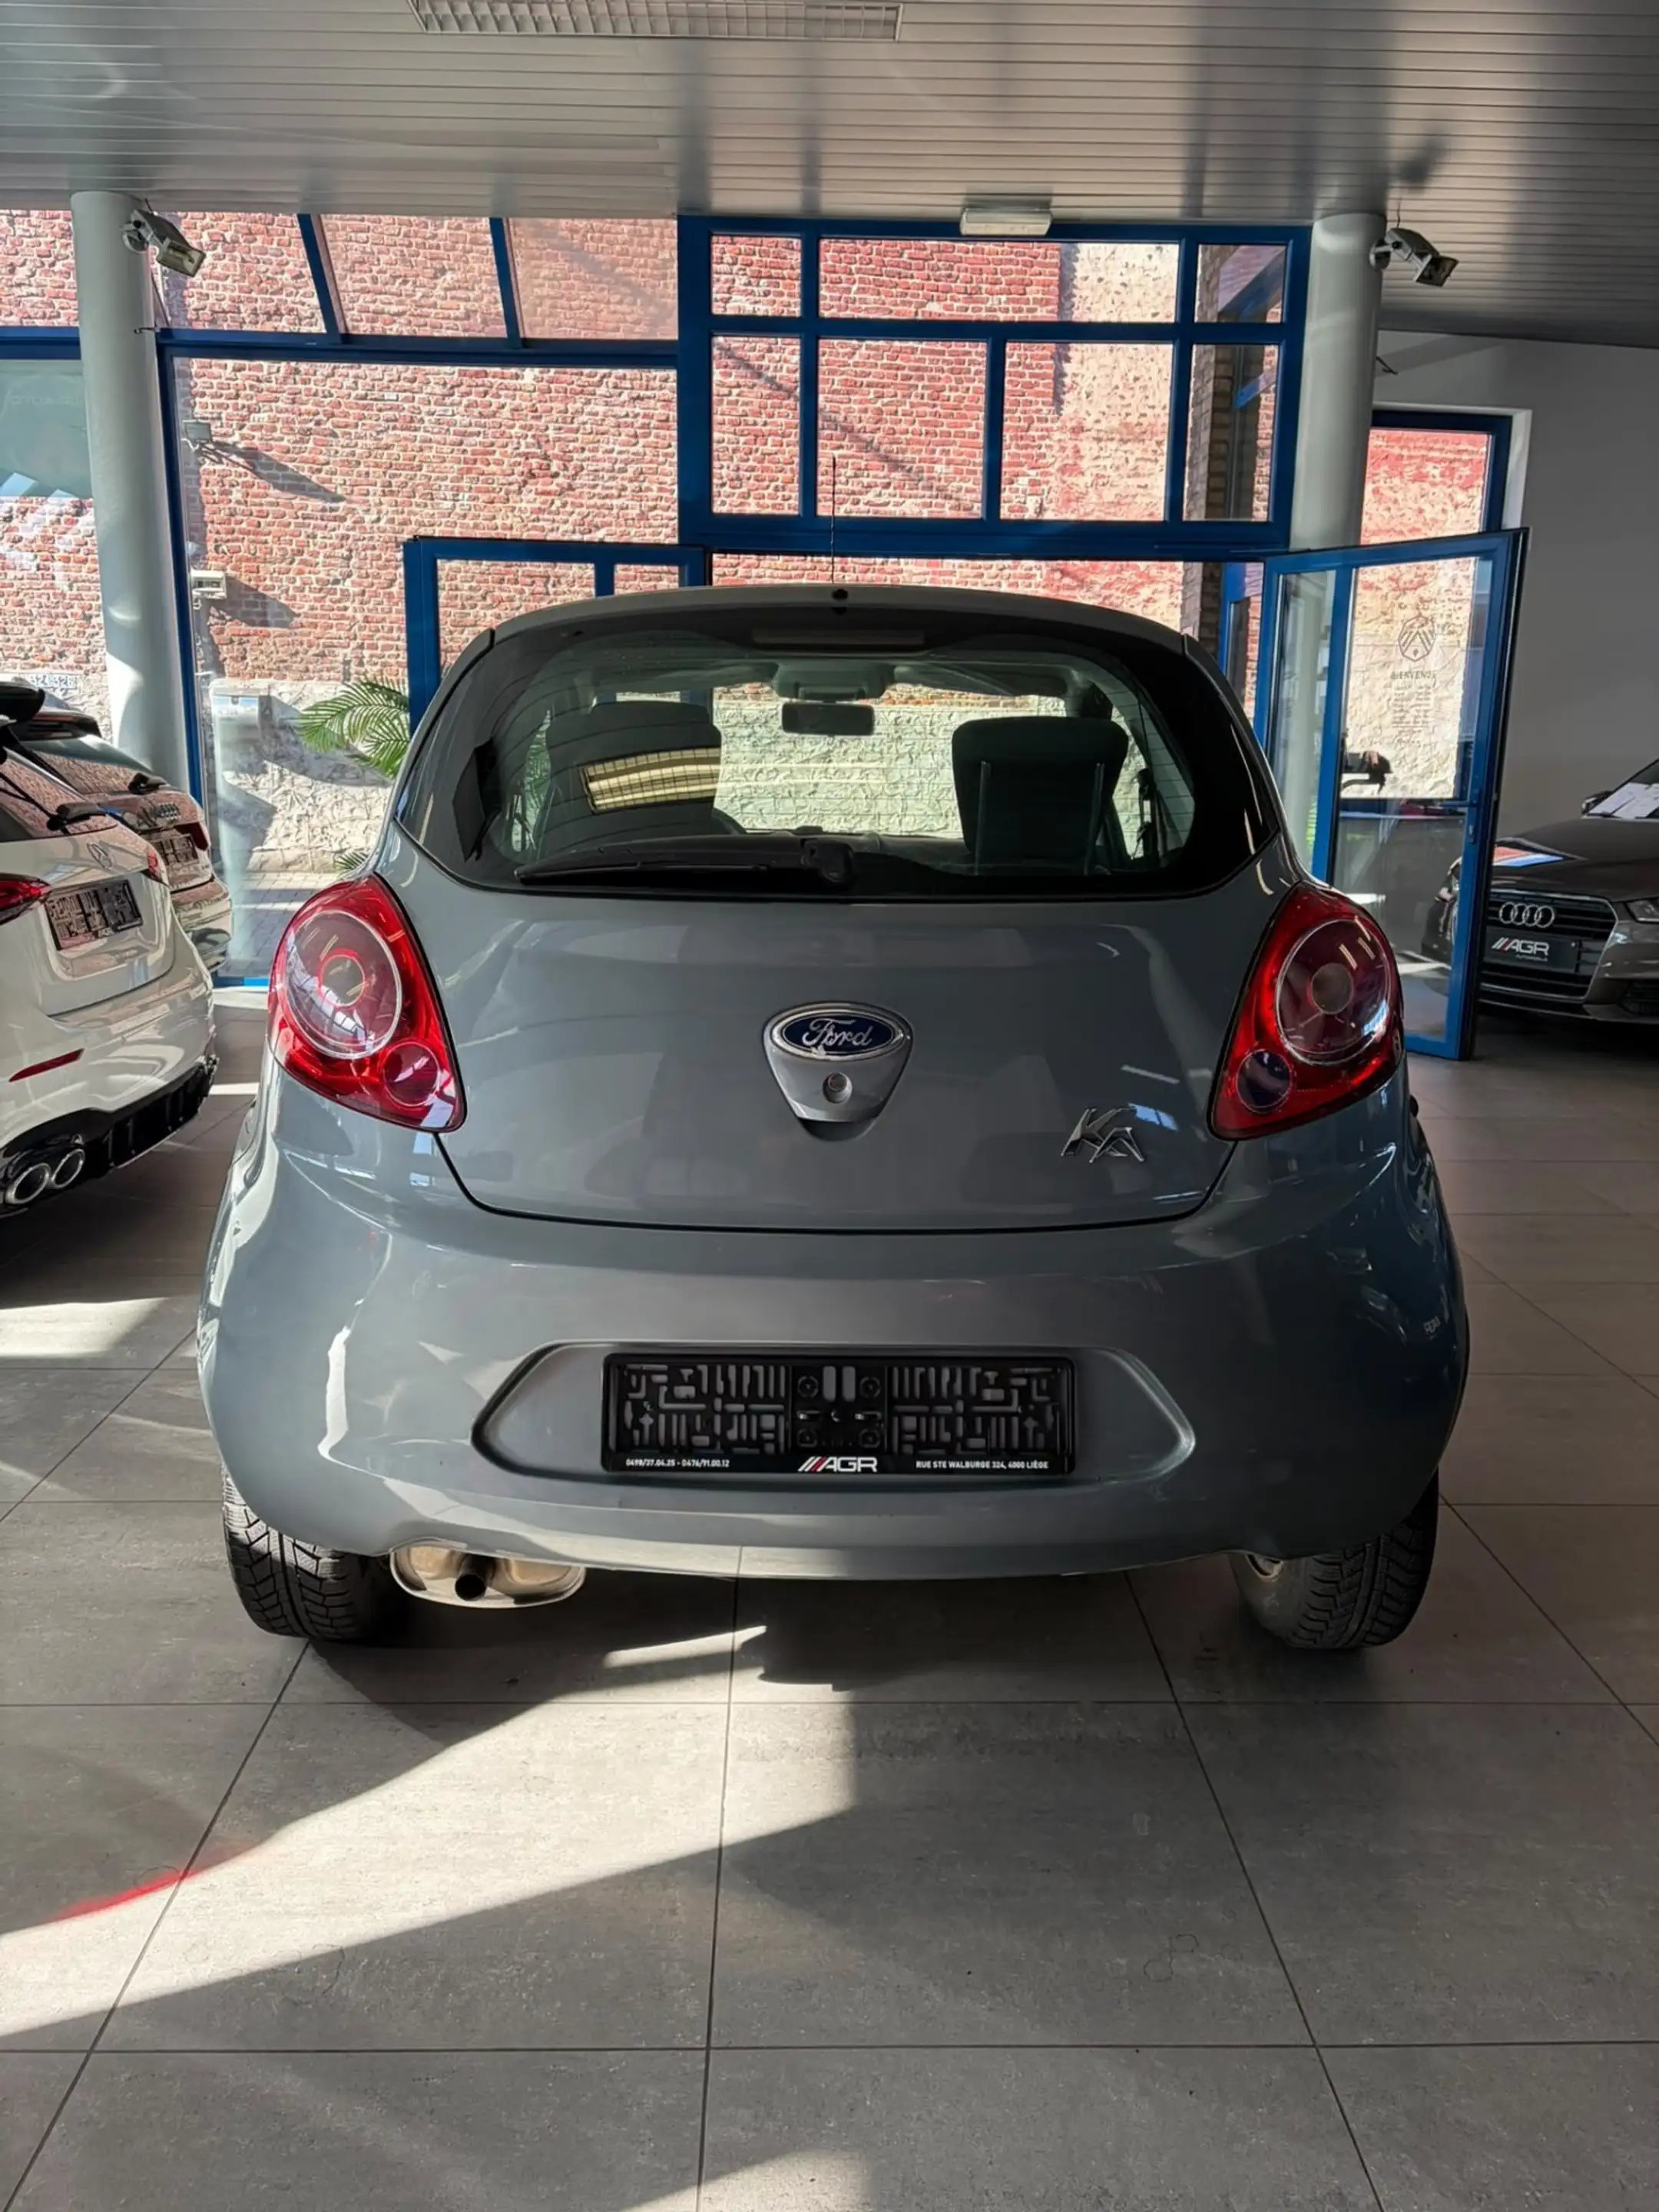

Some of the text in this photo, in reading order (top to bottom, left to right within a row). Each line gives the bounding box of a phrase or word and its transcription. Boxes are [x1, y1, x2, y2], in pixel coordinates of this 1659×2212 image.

[801, 1018, 873, 1047] Ford
[916, 1460, 932, 1469] RUE
[932, 1460, 947, 1469] STE
